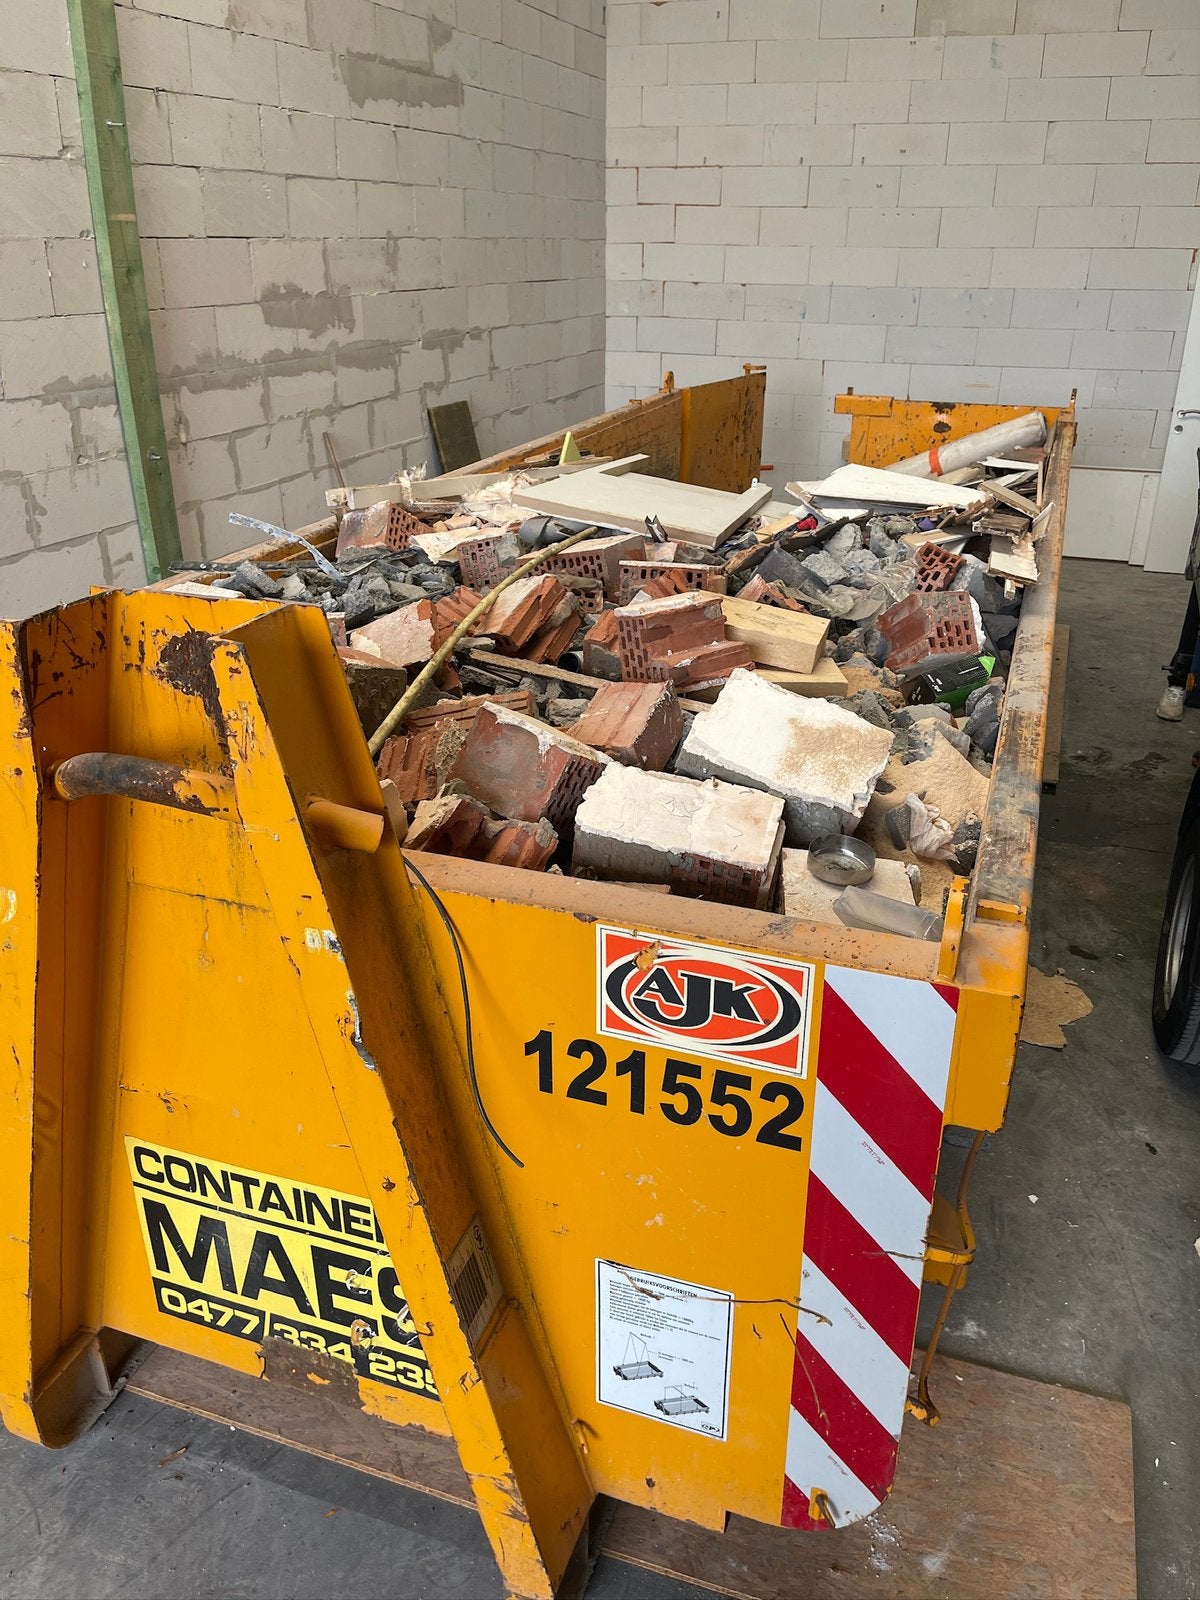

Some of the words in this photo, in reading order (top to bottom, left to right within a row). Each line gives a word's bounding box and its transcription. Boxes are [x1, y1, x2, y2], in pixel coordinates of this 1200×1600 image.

[631, 966, 766, 1029] AJK
[524, 1029, 805, 1152] 121552
[133, 1145, 385, 1245] CONTAINE
[141, 1196, 424, 1350] MAES
[160, 1286, 261, 1336] 0477
[273, 1322, 356, 1364] 334
